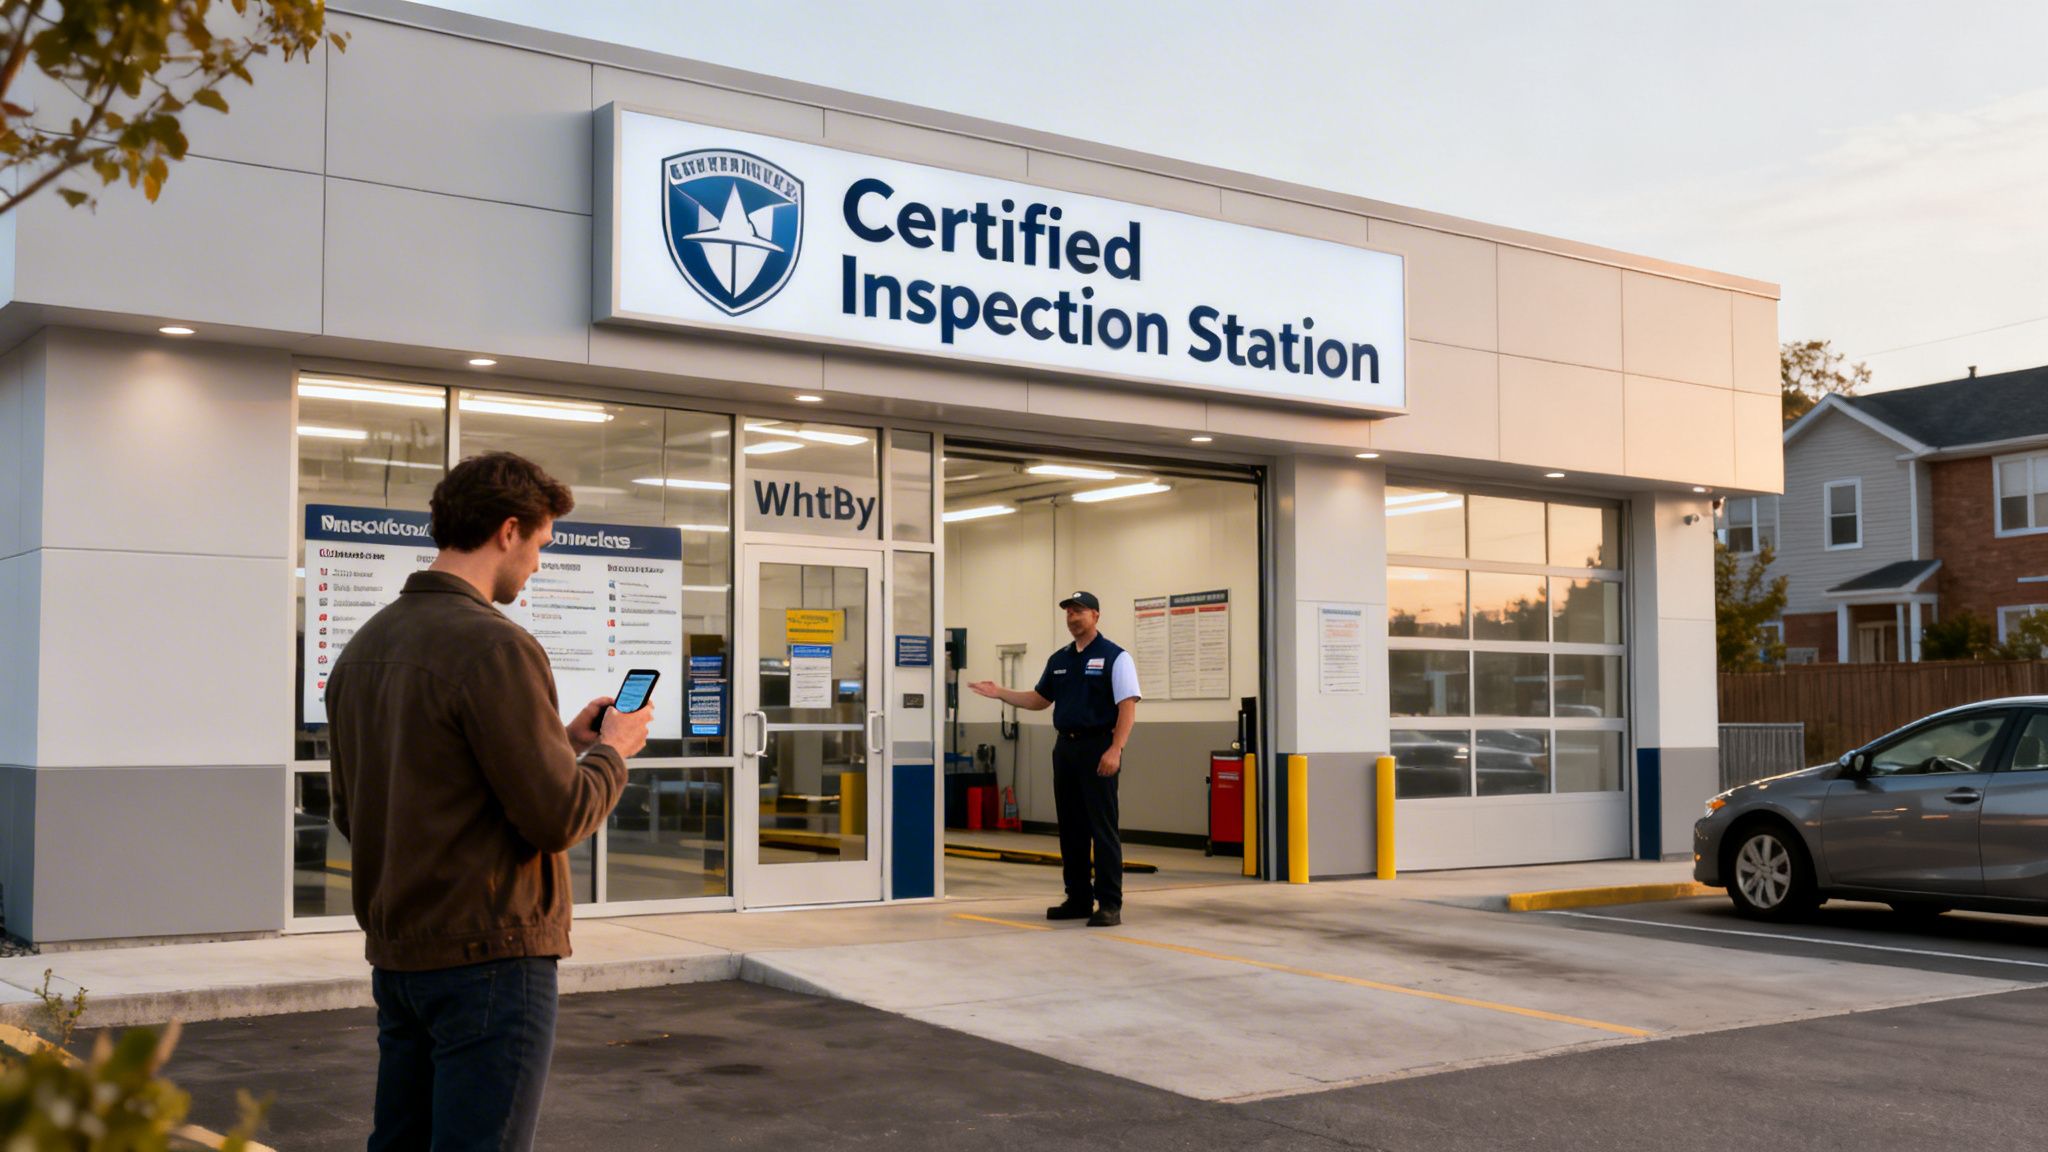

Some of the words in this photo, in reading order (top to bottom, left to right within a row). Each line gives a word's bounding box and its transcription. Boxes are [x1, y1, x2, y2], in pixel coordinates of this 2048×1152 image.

[843, 178, 1141, 282] Certified
[842, 254, 1168, 355] Inspection
[1187, 305, 1380, 384] Station
[754, 480, 876, 531] WhtBy
